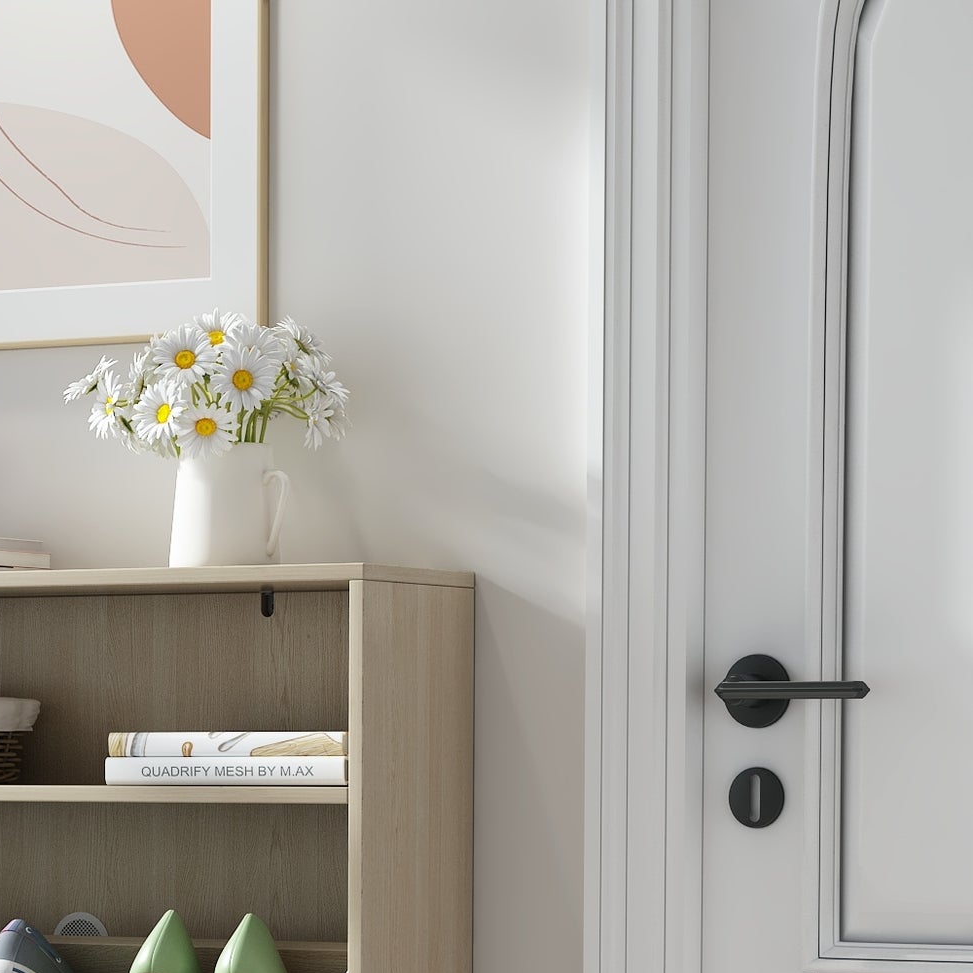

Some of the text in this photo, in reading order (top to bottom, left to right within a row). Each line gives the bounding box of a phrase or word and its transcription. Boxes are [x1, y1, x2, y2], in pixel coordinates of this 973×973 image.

[141, 766, 314, 778] QUADRIFY MESH BY M.AX
